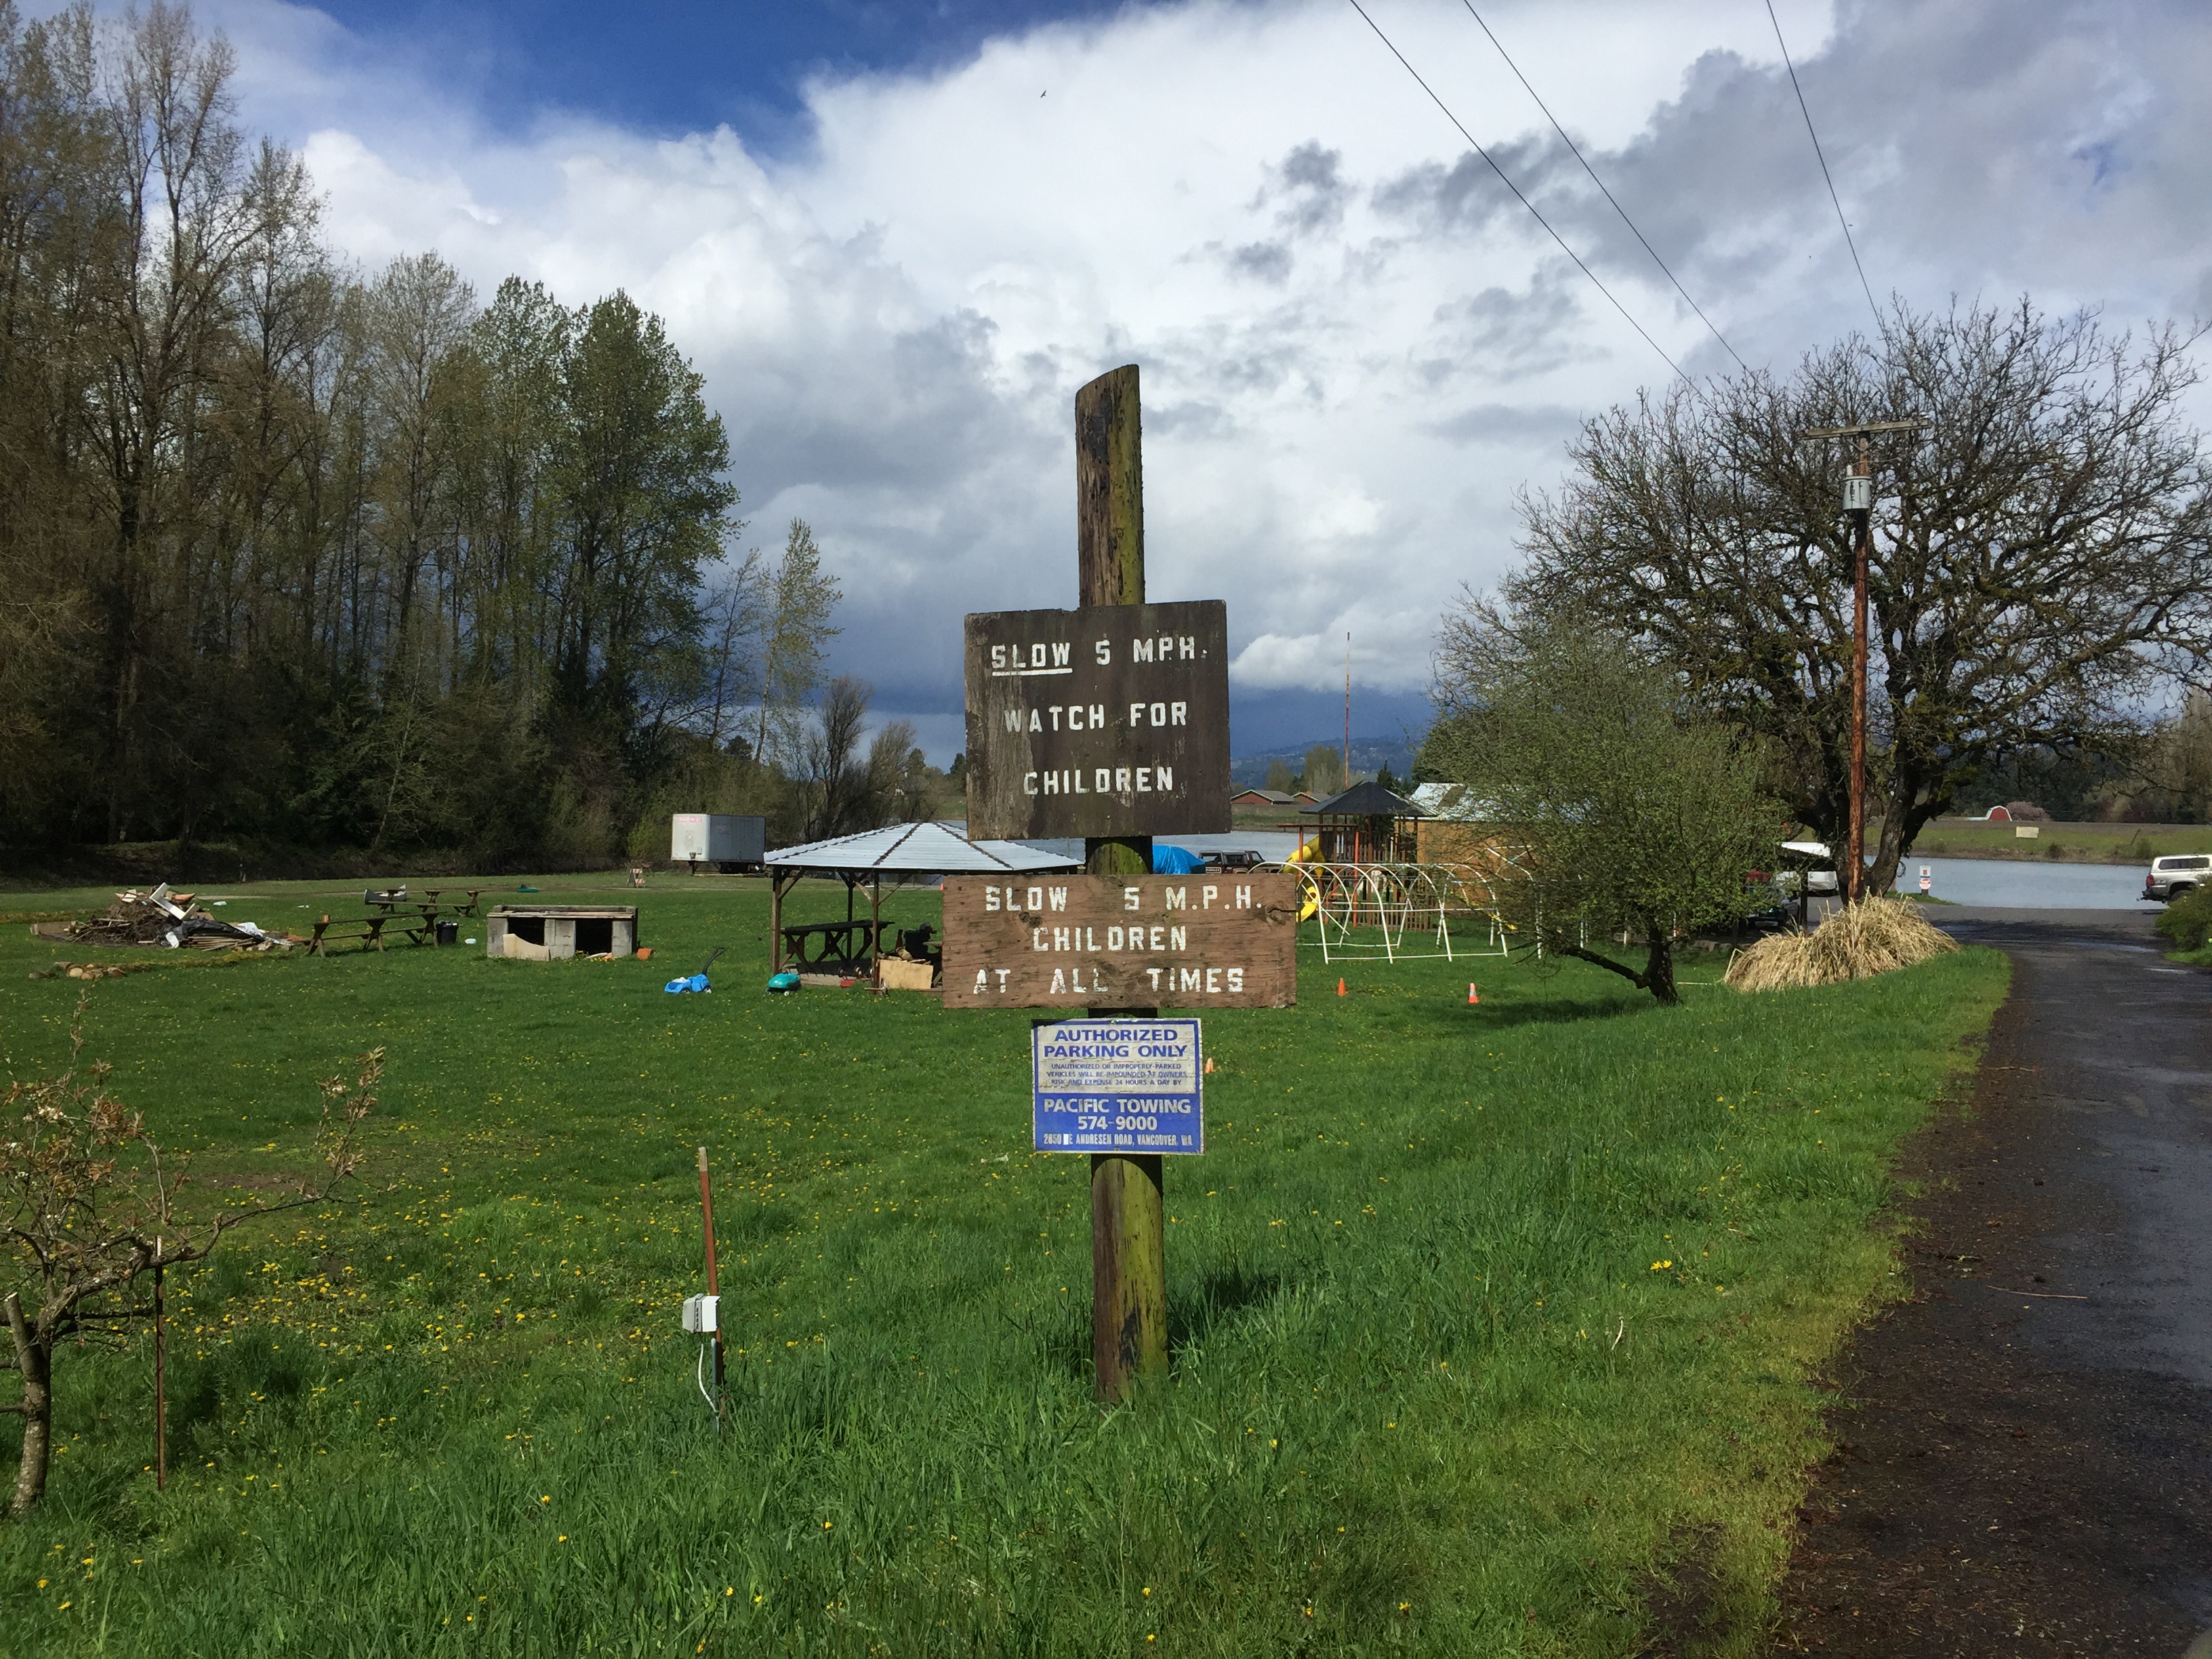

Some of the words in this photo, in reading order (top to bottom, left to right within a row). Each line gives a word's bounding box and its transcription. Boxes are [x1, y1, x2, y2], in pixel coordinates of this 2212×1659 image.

[991, 642, 1071, 669] SLOW
[1095, 639, 1111, 665] 5
[1004, 703, 1105, 733] WATCH
[1130, 701, 1187, 727] FOR
[1023, 766, 1174, 796] CHILDREN
[985, 885, 1068, 912] SLOW
[1124, 886, 1140, 911] 5
[1166, 884, 1262, 911] M.P.H.
[1033, 925, 1187, 951] CHILDREN
[973, 968, 1011, 995] AT
[1050, 968, 1109, 994] ALL
[1146, 967, 1244, 994] TIMES
[1054, 1029, 1178, 1042] AUTHORIZED
[1044, 1045, 1129, 1057] PARKING
[1138, 1044, 1188, 1057] ONLY
[1044, 1098, 1109, 1113] PACIFIC
[1117, 1099, 1191, 1113] TOWING
[1078, 1115, 1158, 1130] 574-9000
[1043, 1133, 1062, 1145] 2650
[1063, 1133, 1073, 1145] E
[1076, 1133, 1111, 1145] ANDRESEN
[1114, 1133, 1134, 1146] ROAD,
[1137, 1134, 1179, 1146] VANCOUVER,
[1181, 1134, 1193, 1146] WA
